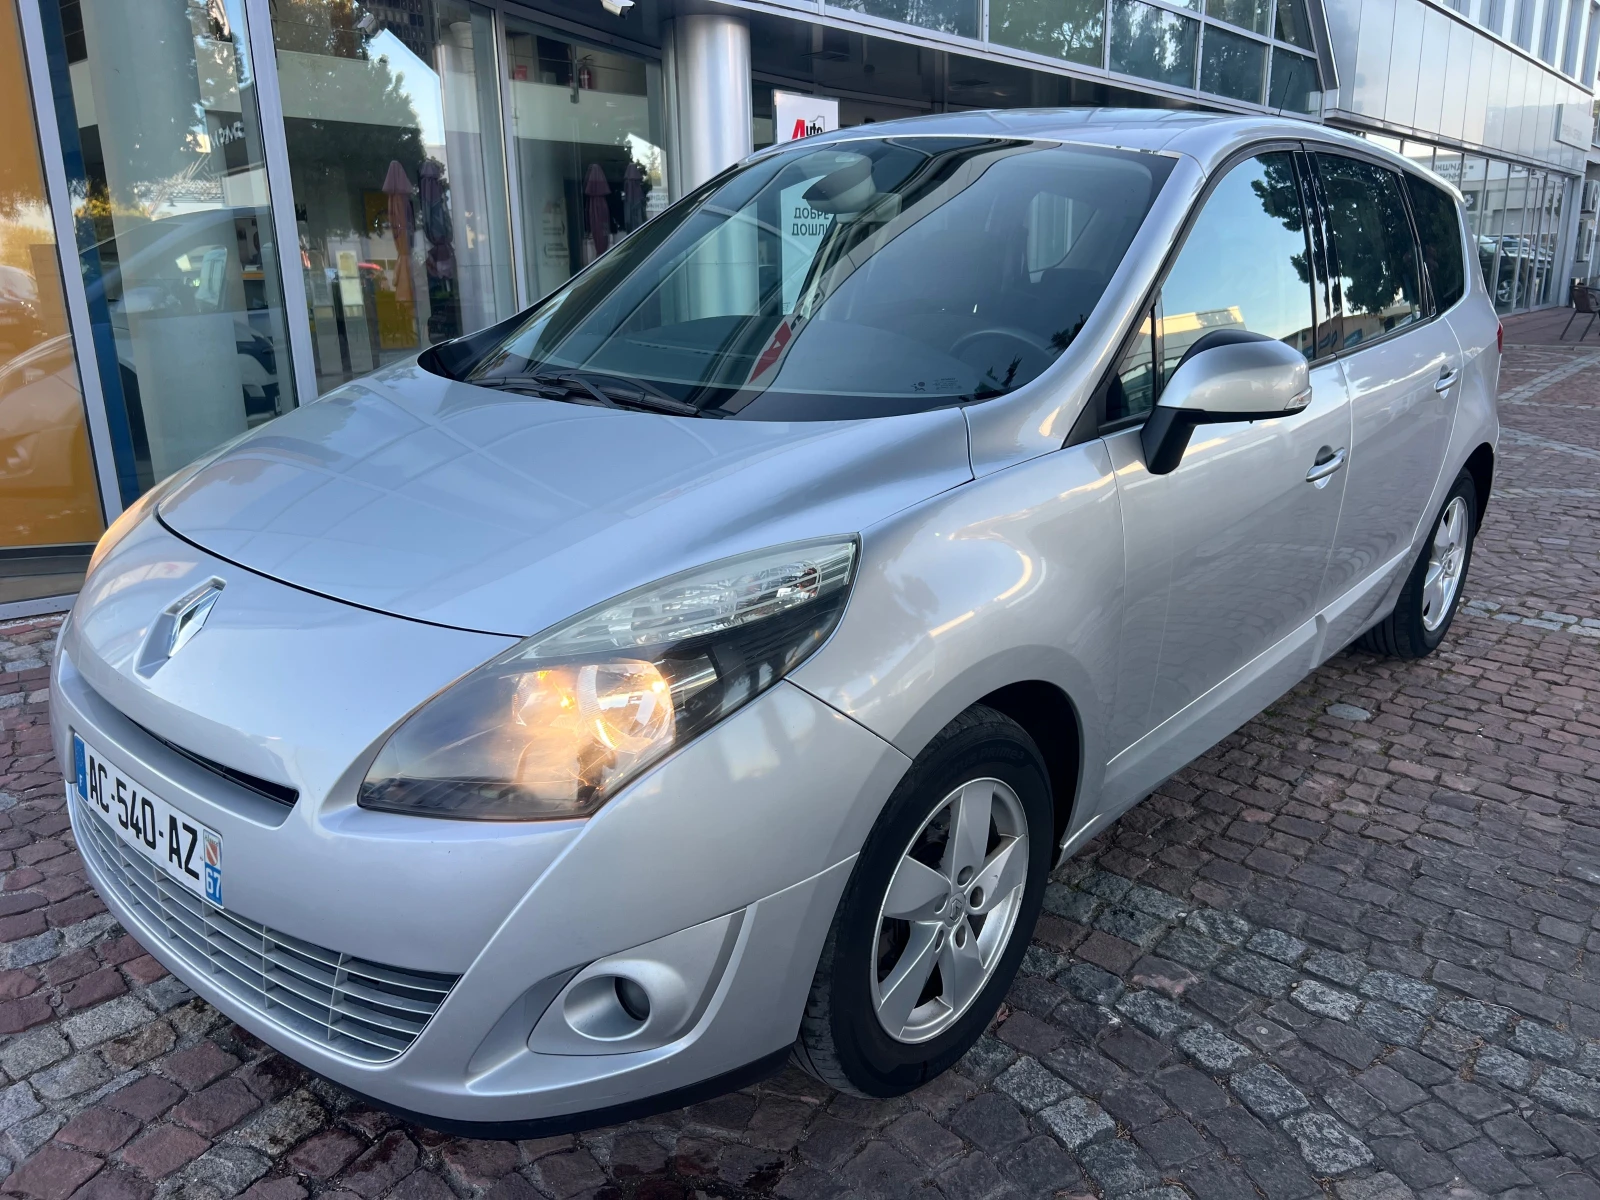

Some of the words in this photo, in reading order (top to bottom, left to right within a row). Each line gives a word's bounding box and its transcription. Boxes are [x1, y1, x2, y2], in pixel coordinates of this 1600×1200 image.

[791, 223, 828, 236] ДОШЛ
[89, 755, 200, 881] AC-540-AZ
[205, 867, 221, 899] 67
